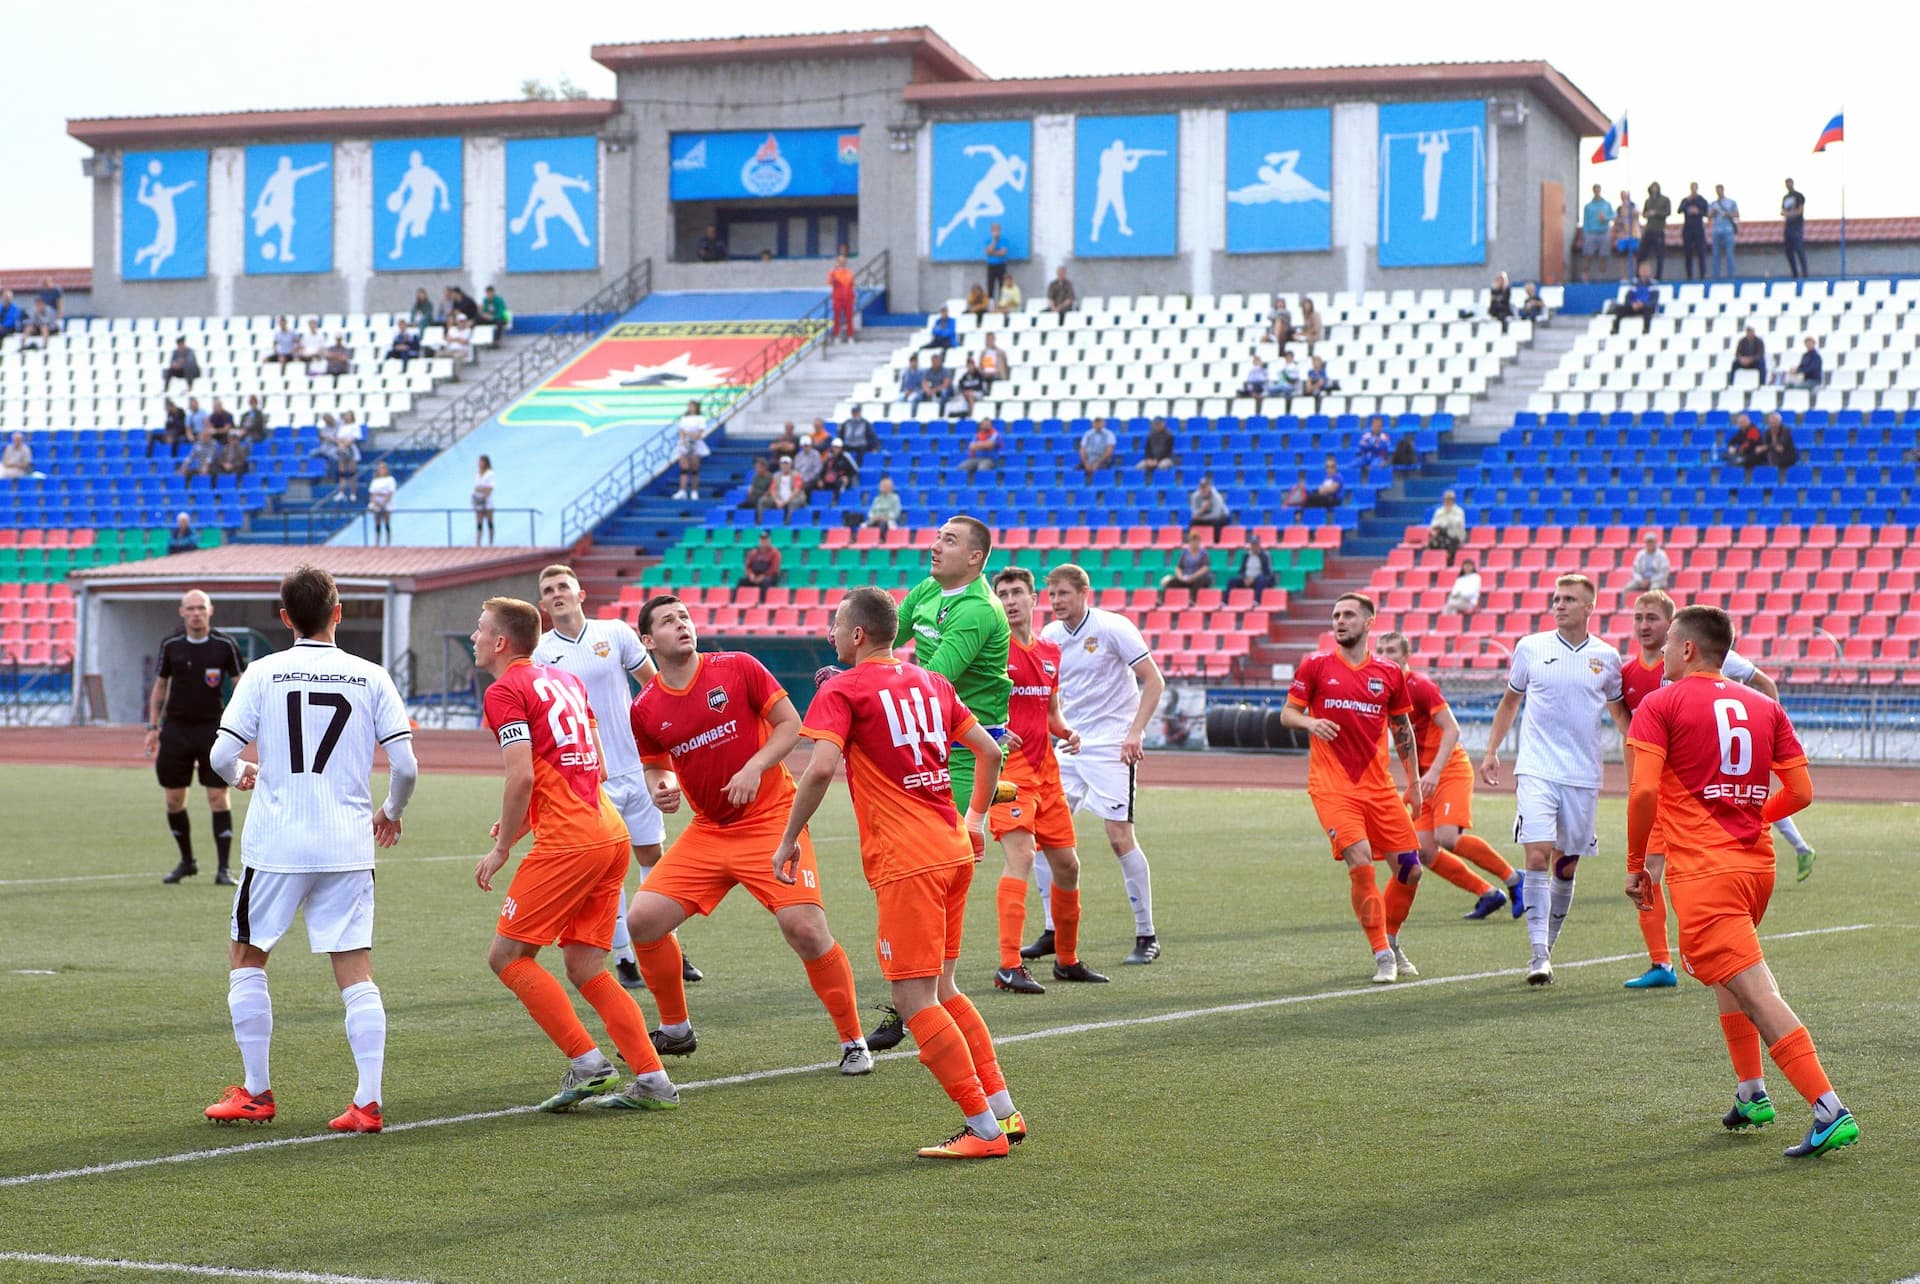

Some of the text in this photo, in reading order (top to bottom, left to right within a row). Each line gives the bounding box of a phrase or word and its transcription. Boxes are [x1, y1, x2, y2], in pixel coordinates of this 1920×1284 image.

[533, 678, 593, 748] 24
[287, 691, 352, 774] 17
[499, 727, 523, 740] AIN
[878, 687, 947, 766] 44
[1713, 698, 1752, 776] 6
[903, 767, 951, 789] SEUS
[1703, 783, 1768, 799] SEUS
[802, 869, 816, 888] 13
[501, 896, 517, 920] 24
